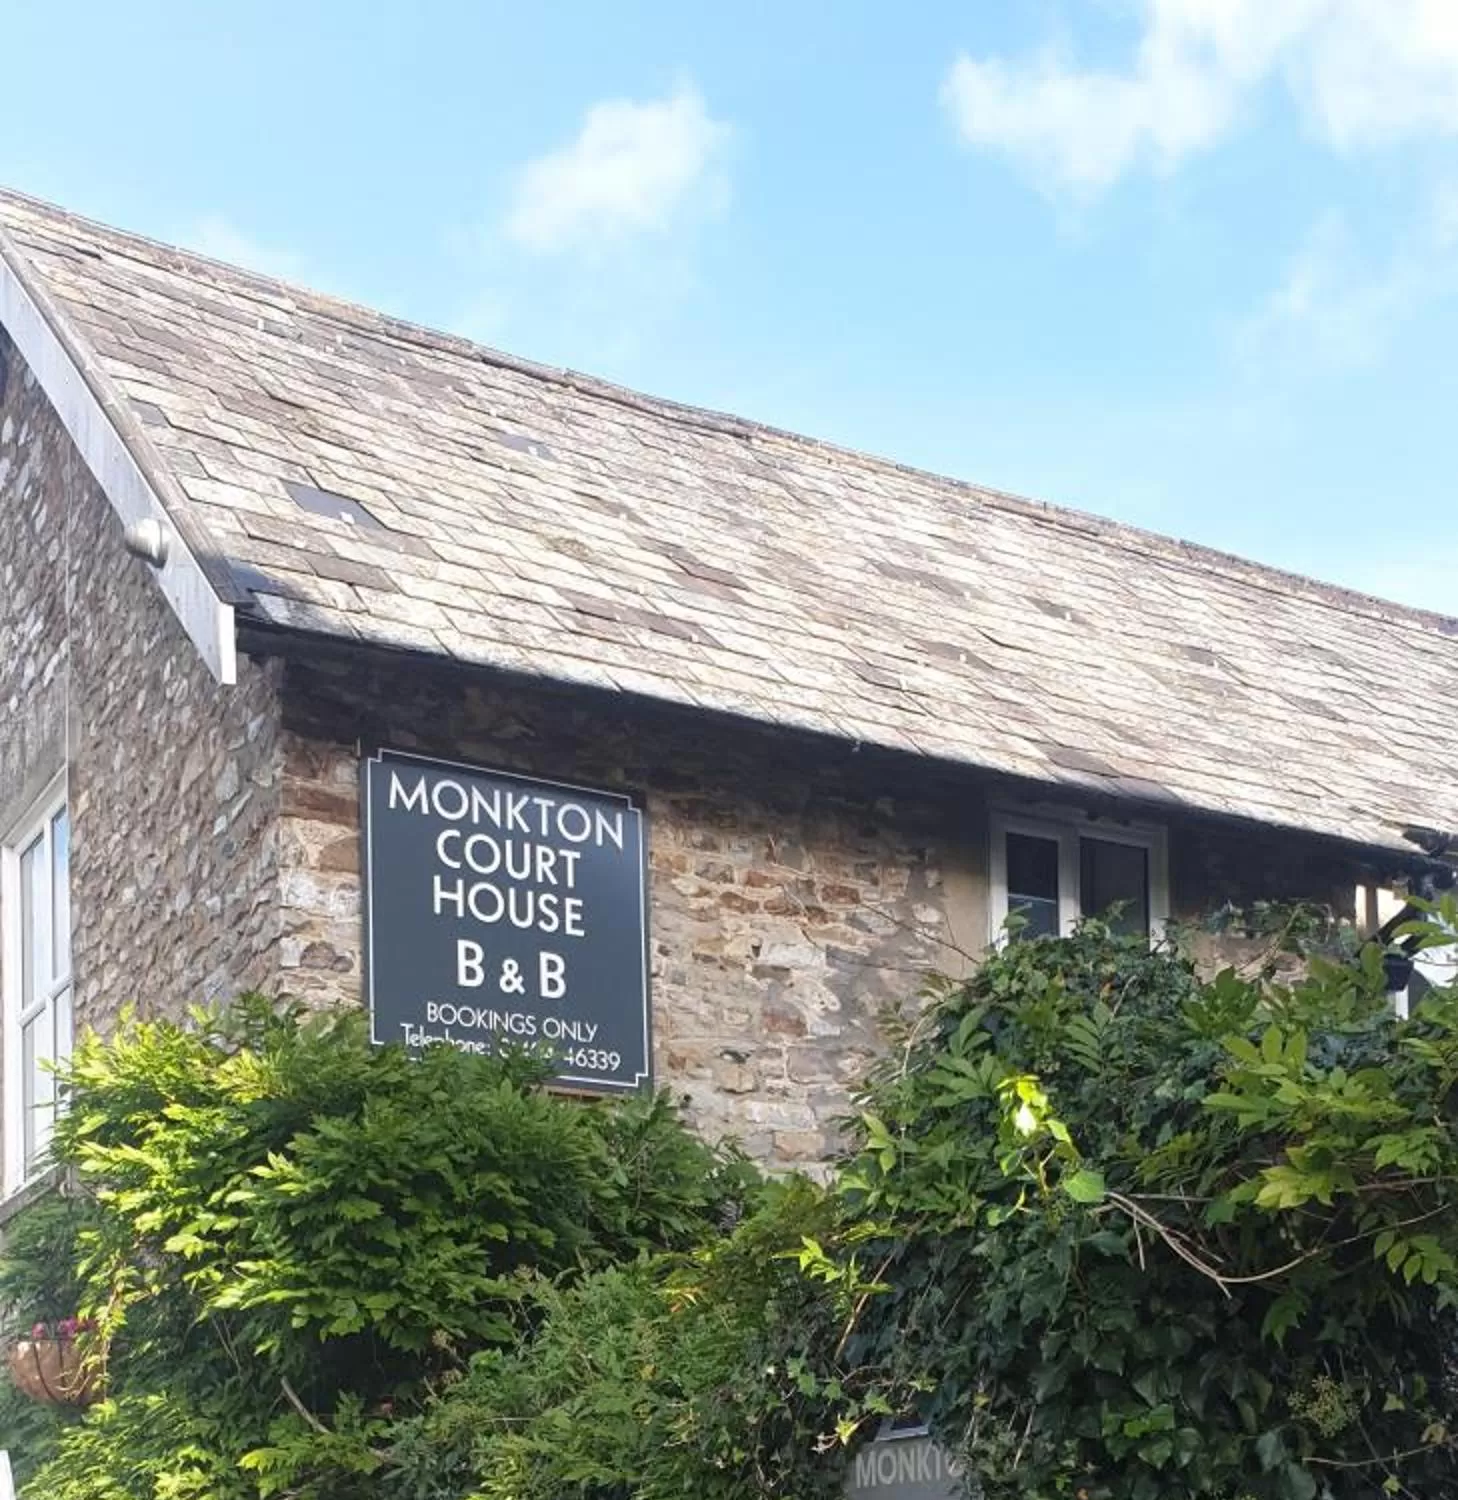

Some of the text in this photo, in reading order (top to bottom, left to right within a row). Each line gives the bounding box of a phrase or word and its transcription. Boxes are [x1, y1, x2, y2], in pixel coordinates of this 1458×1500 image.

[388, 769, 623, 849] MONKTON
[436, 829, 581, 888] COURT
[433, 875, 585, 936] HOUSE
[457, 939, 566, 998] B & B
[427, 1002, 598, 1043] BOOKINGS ONLY
